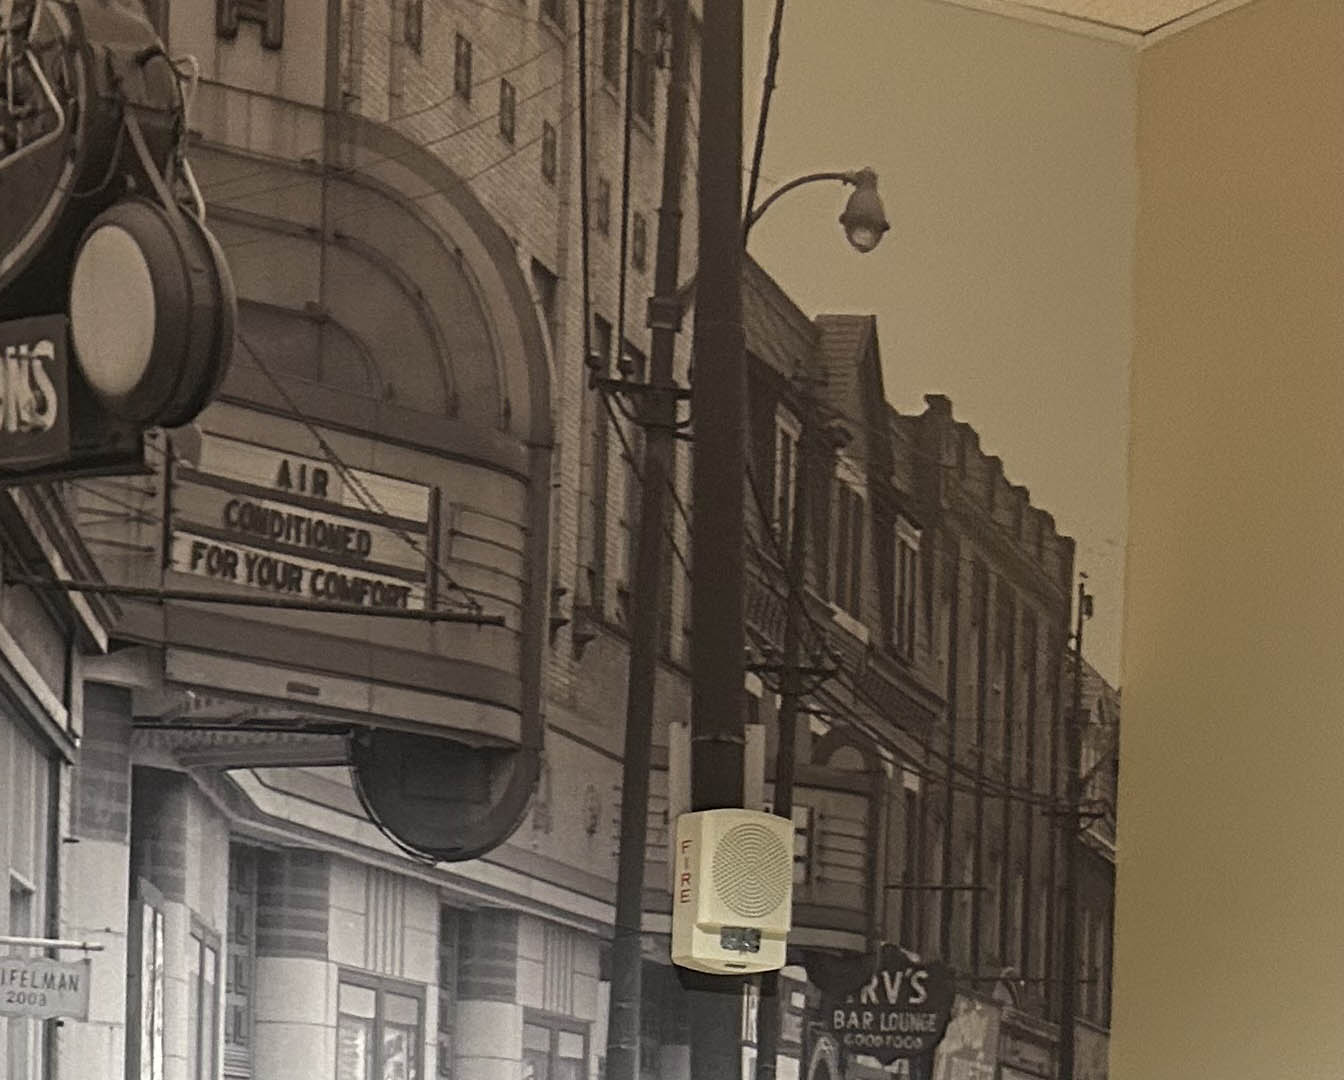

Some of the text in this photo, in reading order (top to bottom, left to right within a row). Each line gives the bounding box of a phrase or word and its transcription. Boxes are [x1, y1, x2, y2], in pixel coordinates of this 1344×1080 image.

[276, 459, 329, 497] AIR
[223, 499, 372, 557] CONDITIONED
[190, 540, 411, 608] FOR YOUR COMFORT
[679, 839, 693, 904] FIRE
[845, 967, 929, 1005] RV'S
[833, 1009, 937, 1033] BAR LOUNGE
